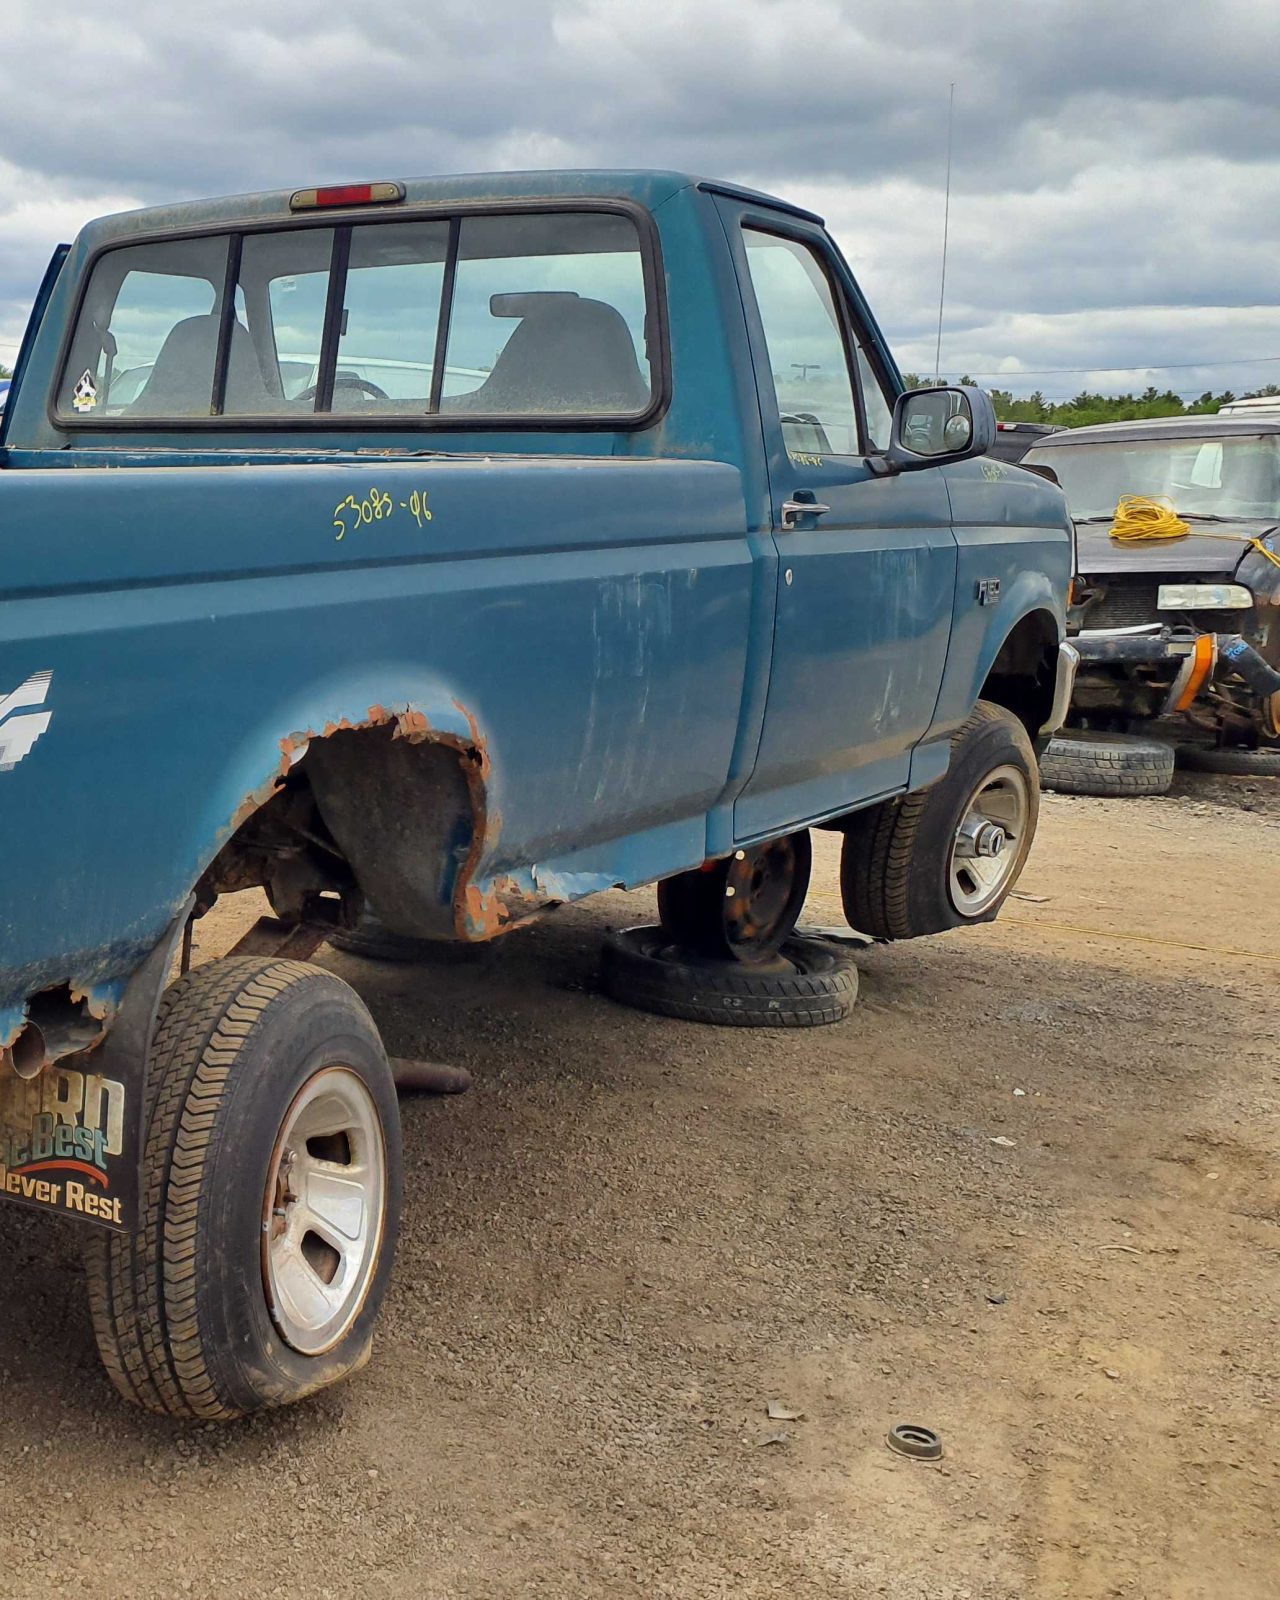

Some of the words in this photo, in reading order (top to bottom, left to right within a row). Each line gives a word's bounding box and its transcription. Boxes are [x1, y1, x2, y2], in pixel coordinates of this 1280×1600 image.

[333, 487, 432, 541] 53085-96
[32, 1112, 108, 1170] Best
[65, 1180, 123, 1224] Rest
